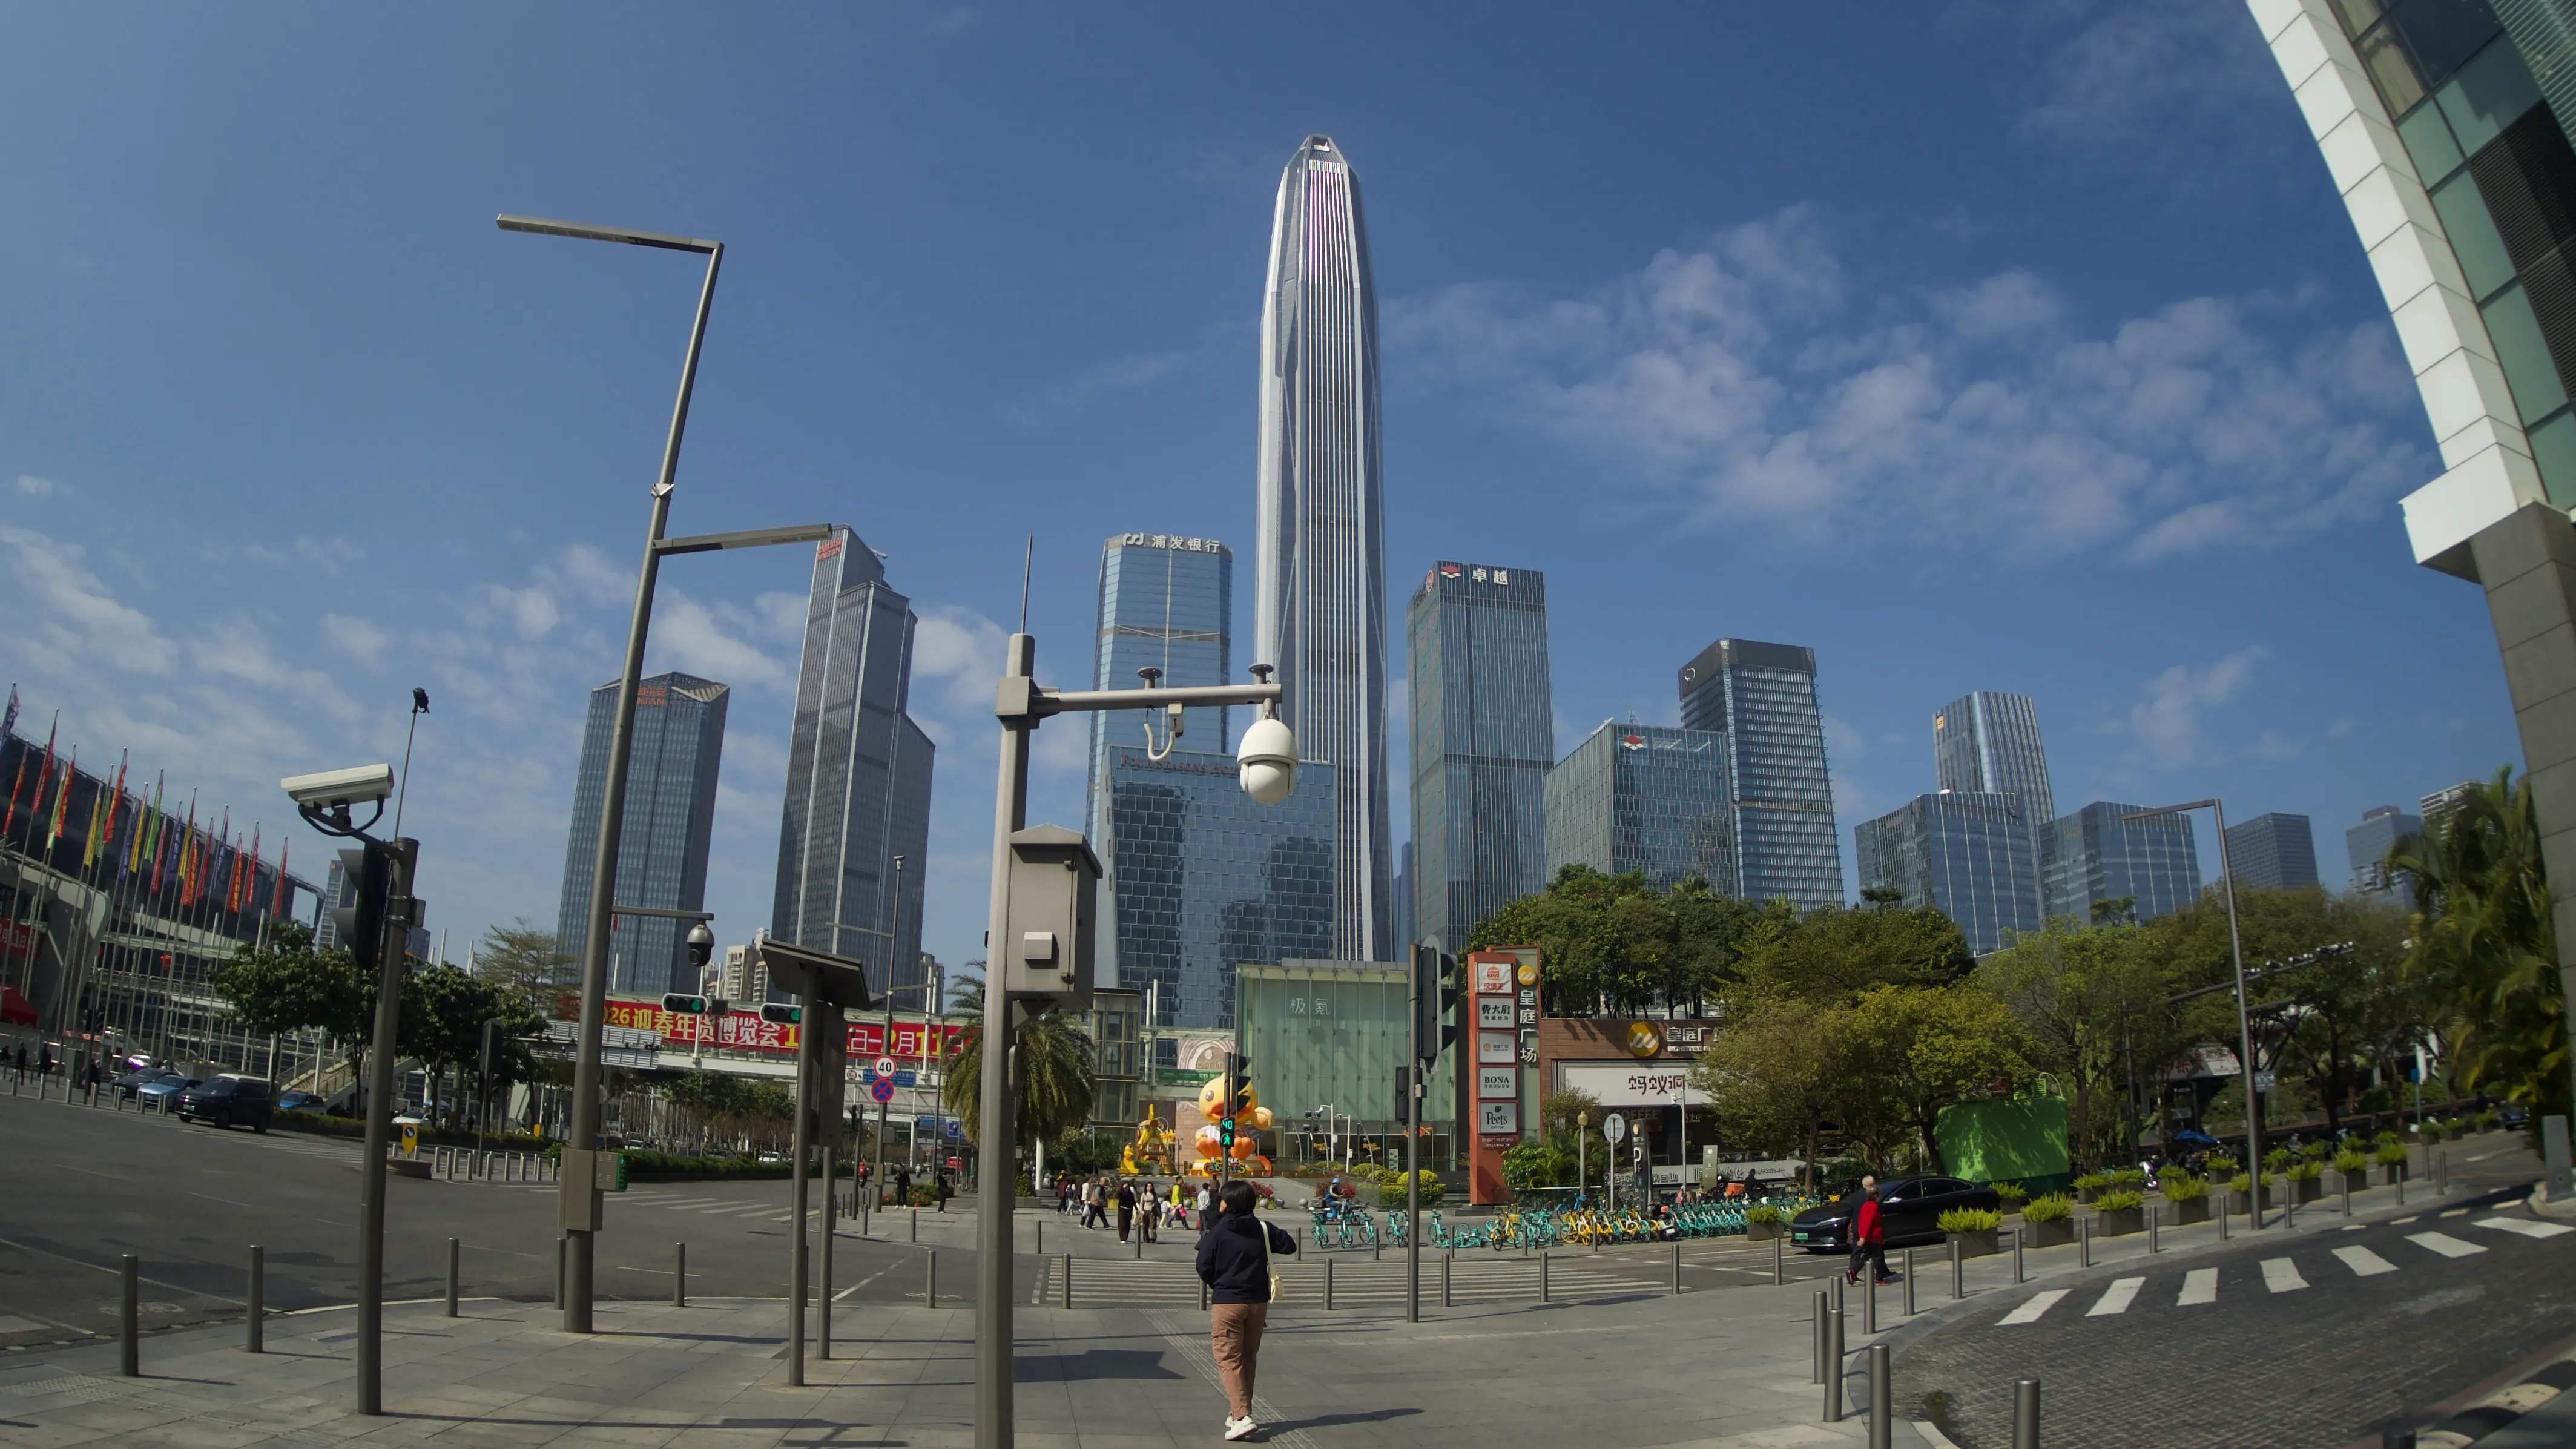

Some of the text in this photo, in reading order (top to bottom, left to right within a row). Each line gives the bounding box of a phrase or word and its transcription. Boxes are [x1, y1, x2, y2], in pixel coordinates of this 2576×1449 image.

[1151, 534, 1220, 553] 浦发银行
[1472, 568, 1508, 585] 卓越
[1290, 997, 1331, 1015] 极氪
[1482, 1004, 1510, 1015] 费大厨
[1519, 989, 1537, 1063] 皇庭广场
[878, 1061, 892, 1072] 40
[1629, 1075, 1685, 1095] 蚂蚁洞
[1222, 1120, 1233, 1129] 40
[1486, 1112, 1507, 1125] Peet's
[1634, 1147, 1641, 1173] P
